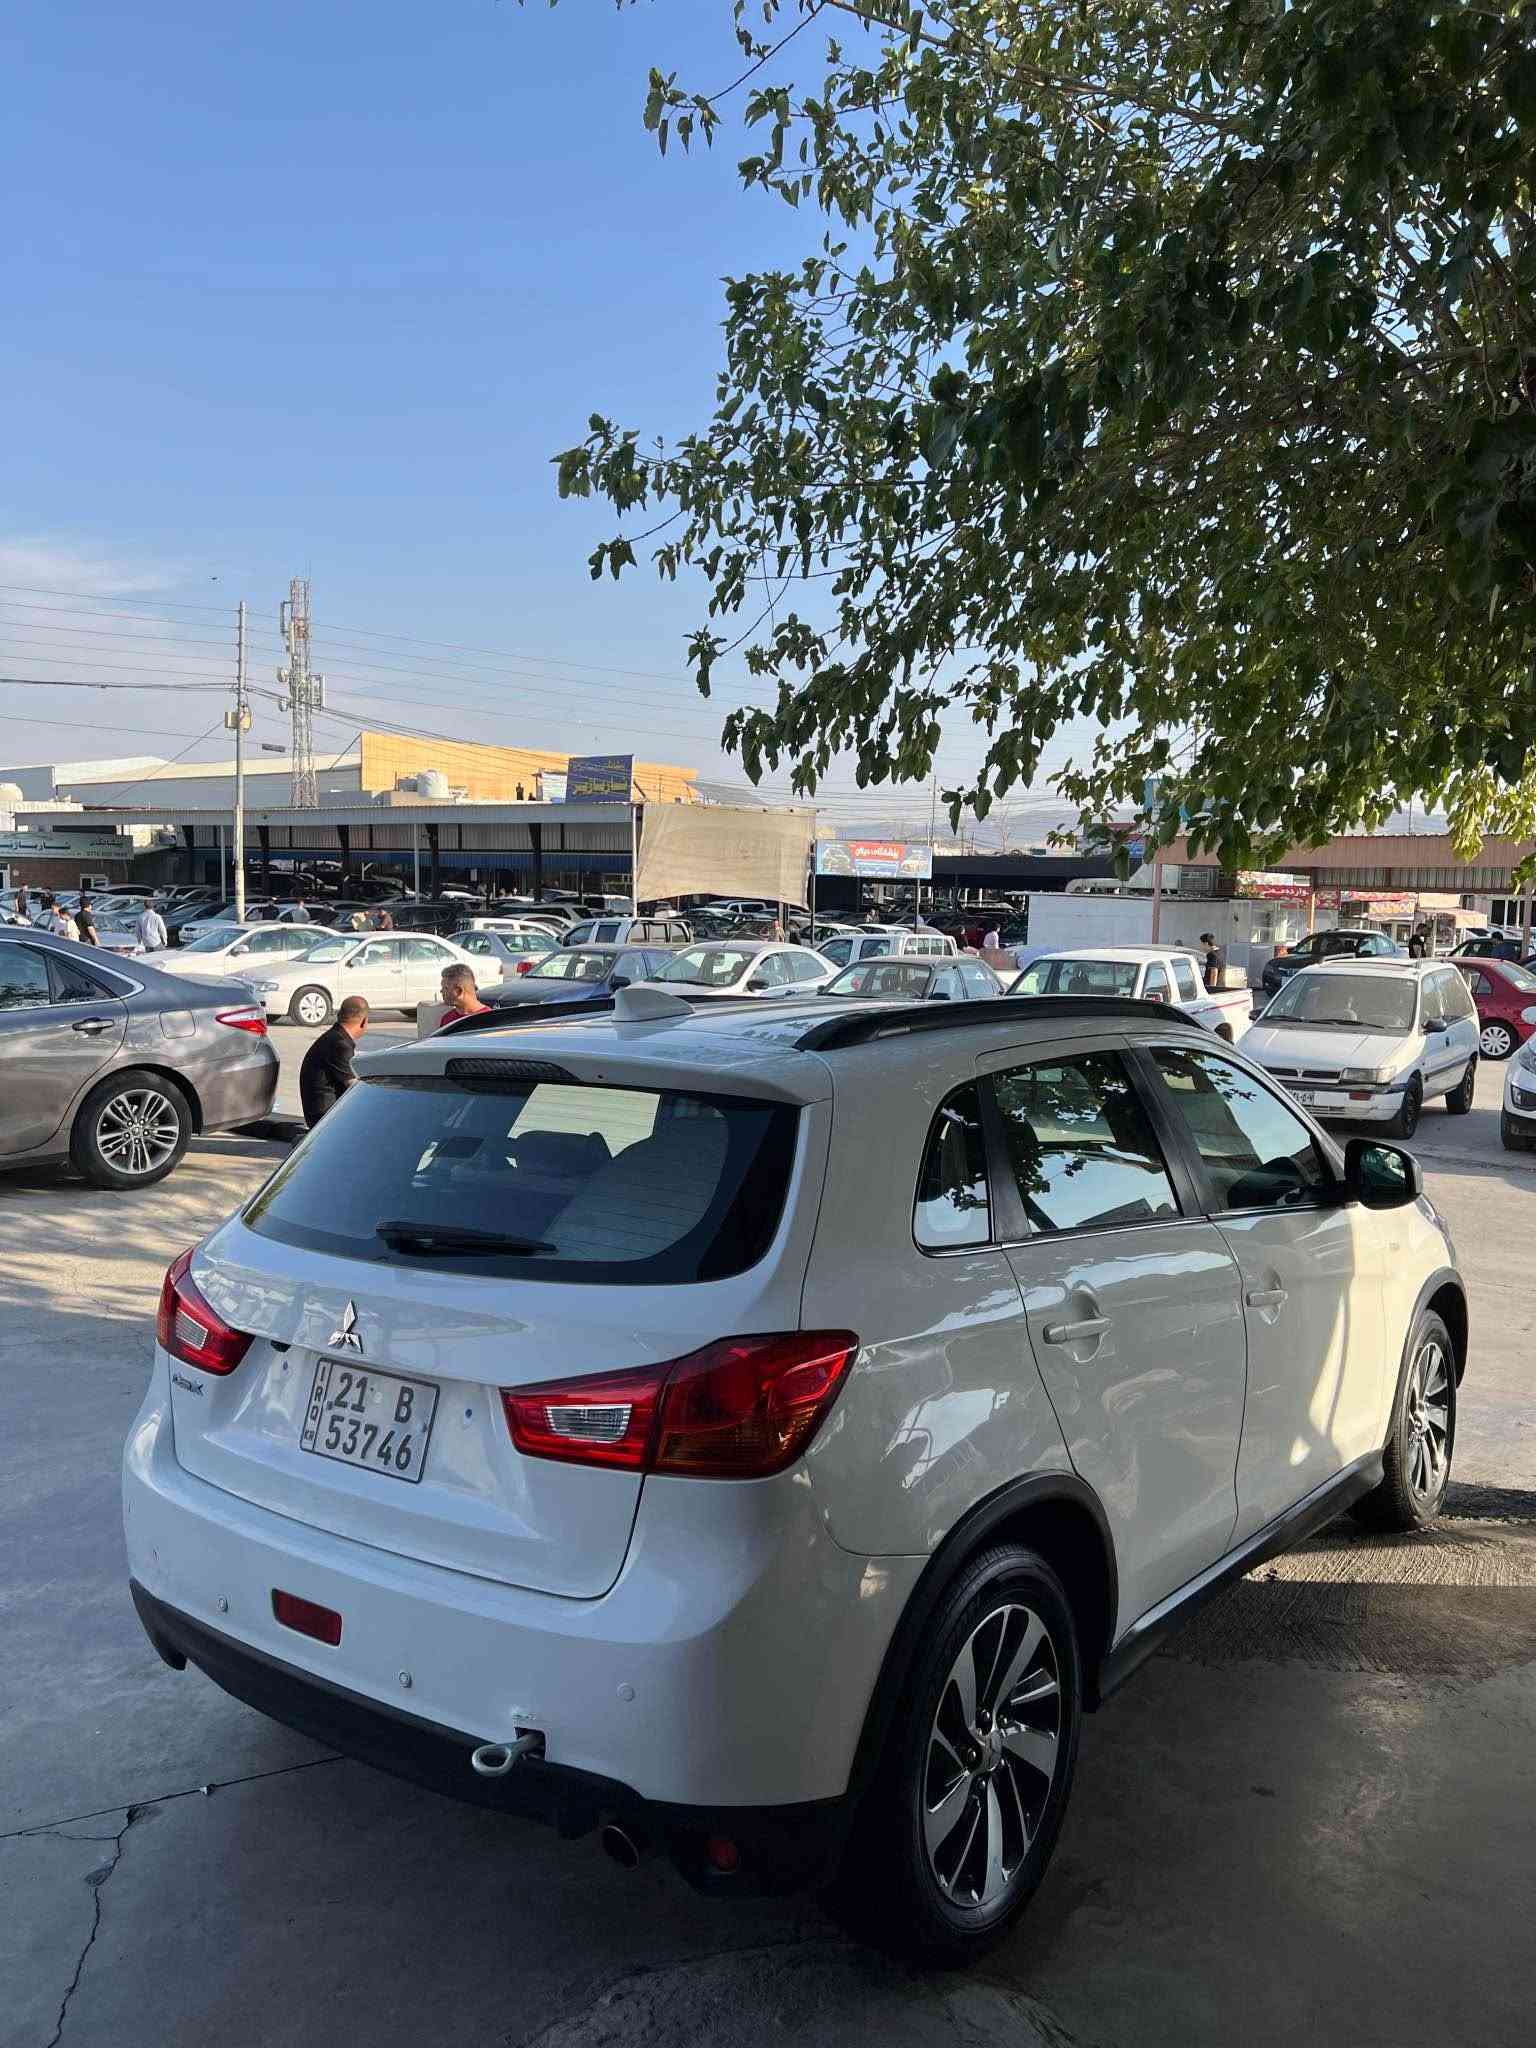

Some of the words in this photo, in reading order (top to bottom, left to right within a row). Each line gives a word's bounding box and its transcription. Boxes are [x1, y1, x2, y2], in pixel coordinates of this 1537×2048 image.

[310, 1366, 326, 1421] IRQ
[334, 1372, 368, 1413] 21
[394, 1386, 414, 1423] B
[303, 1429, 315, 1441] KR
[325, 1414, 412, 1470] 53746
